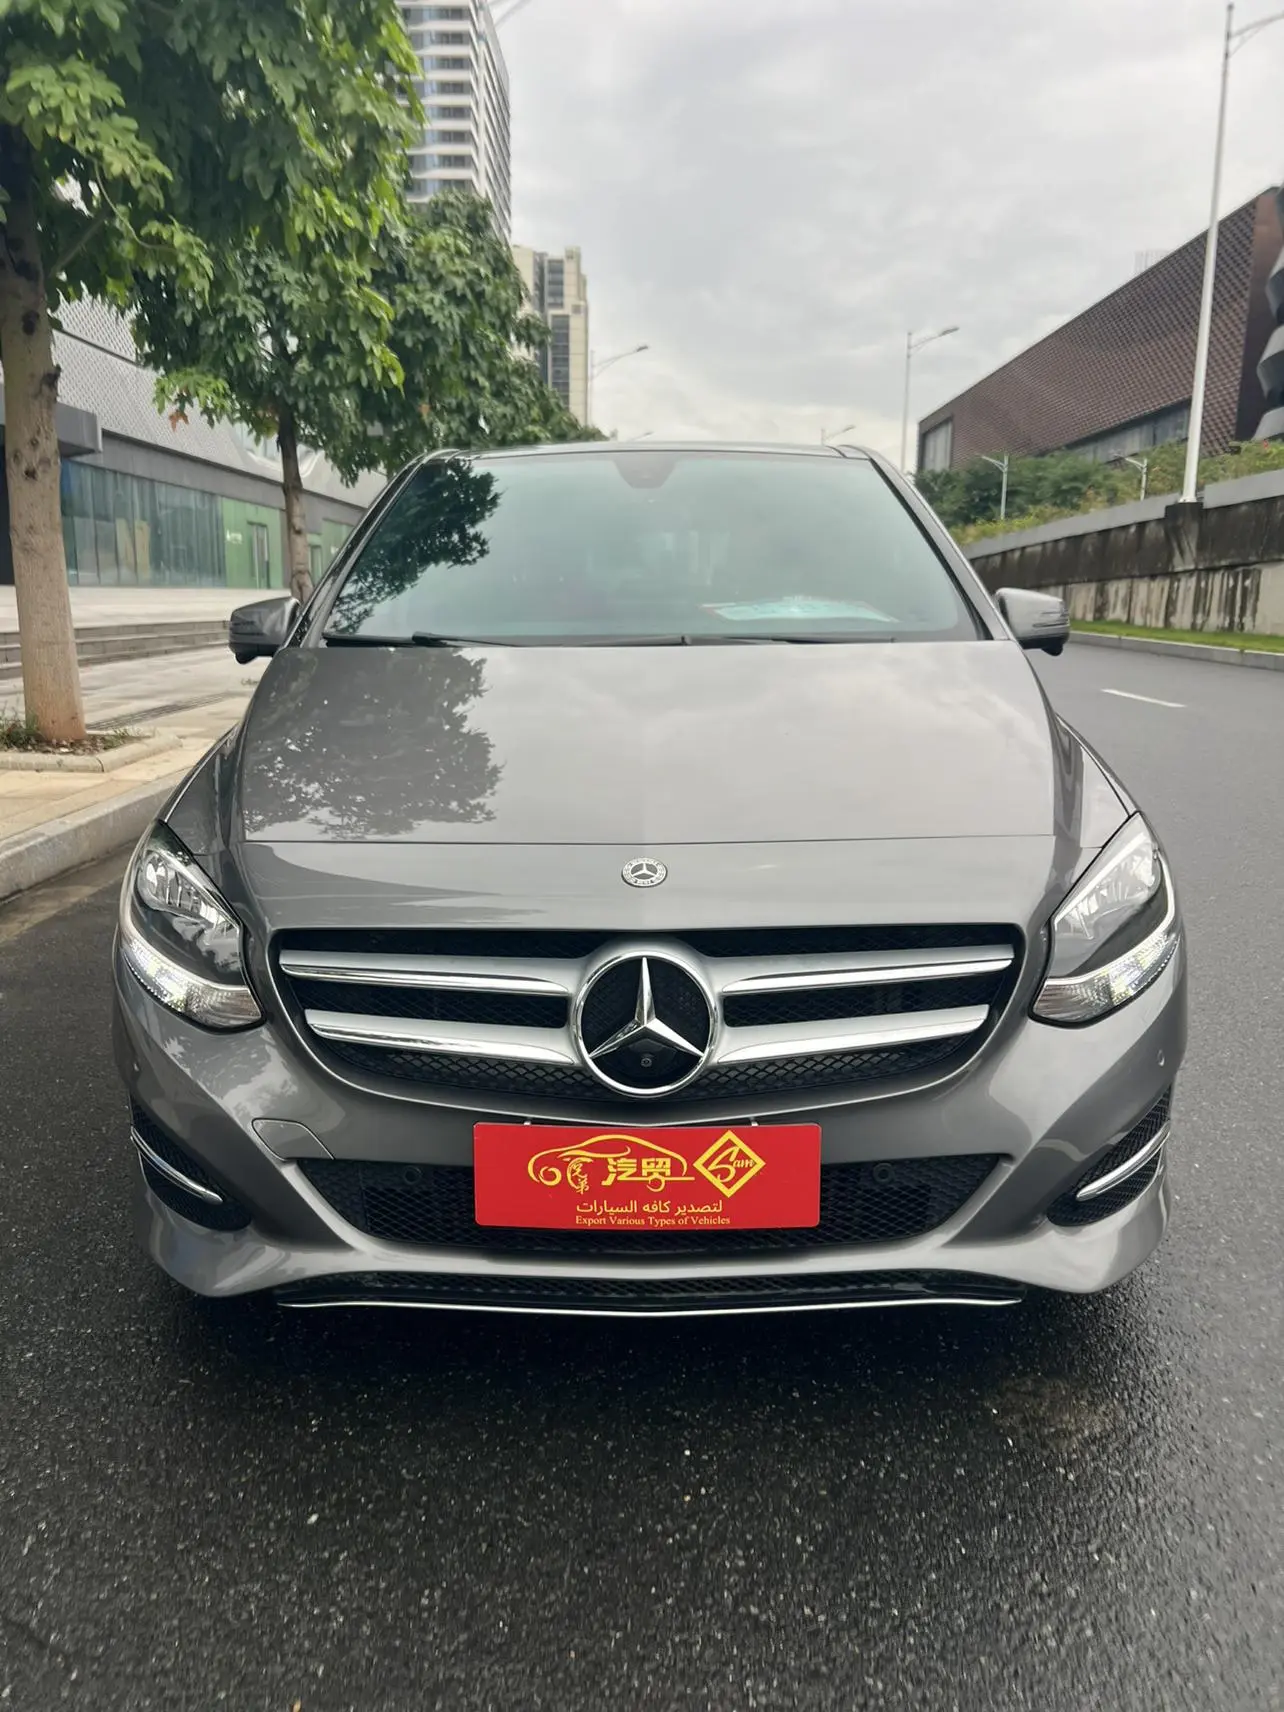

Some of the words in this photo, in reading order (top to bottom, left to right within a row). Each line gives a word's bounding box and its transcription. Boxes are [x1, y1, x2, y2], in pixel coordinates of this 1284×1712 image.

[576, 1199, 637, 1216] السيارات
[674, 1199, 723, 1217] لتصدير
[575, 1215, 607, 1227] Export
[609, 1216, 645, 1226] Various
[647, 1216, 676, 1228] Types
[677, 1216, 690, 1225] of
[690, 1215, 731, 1225] Vehicles
